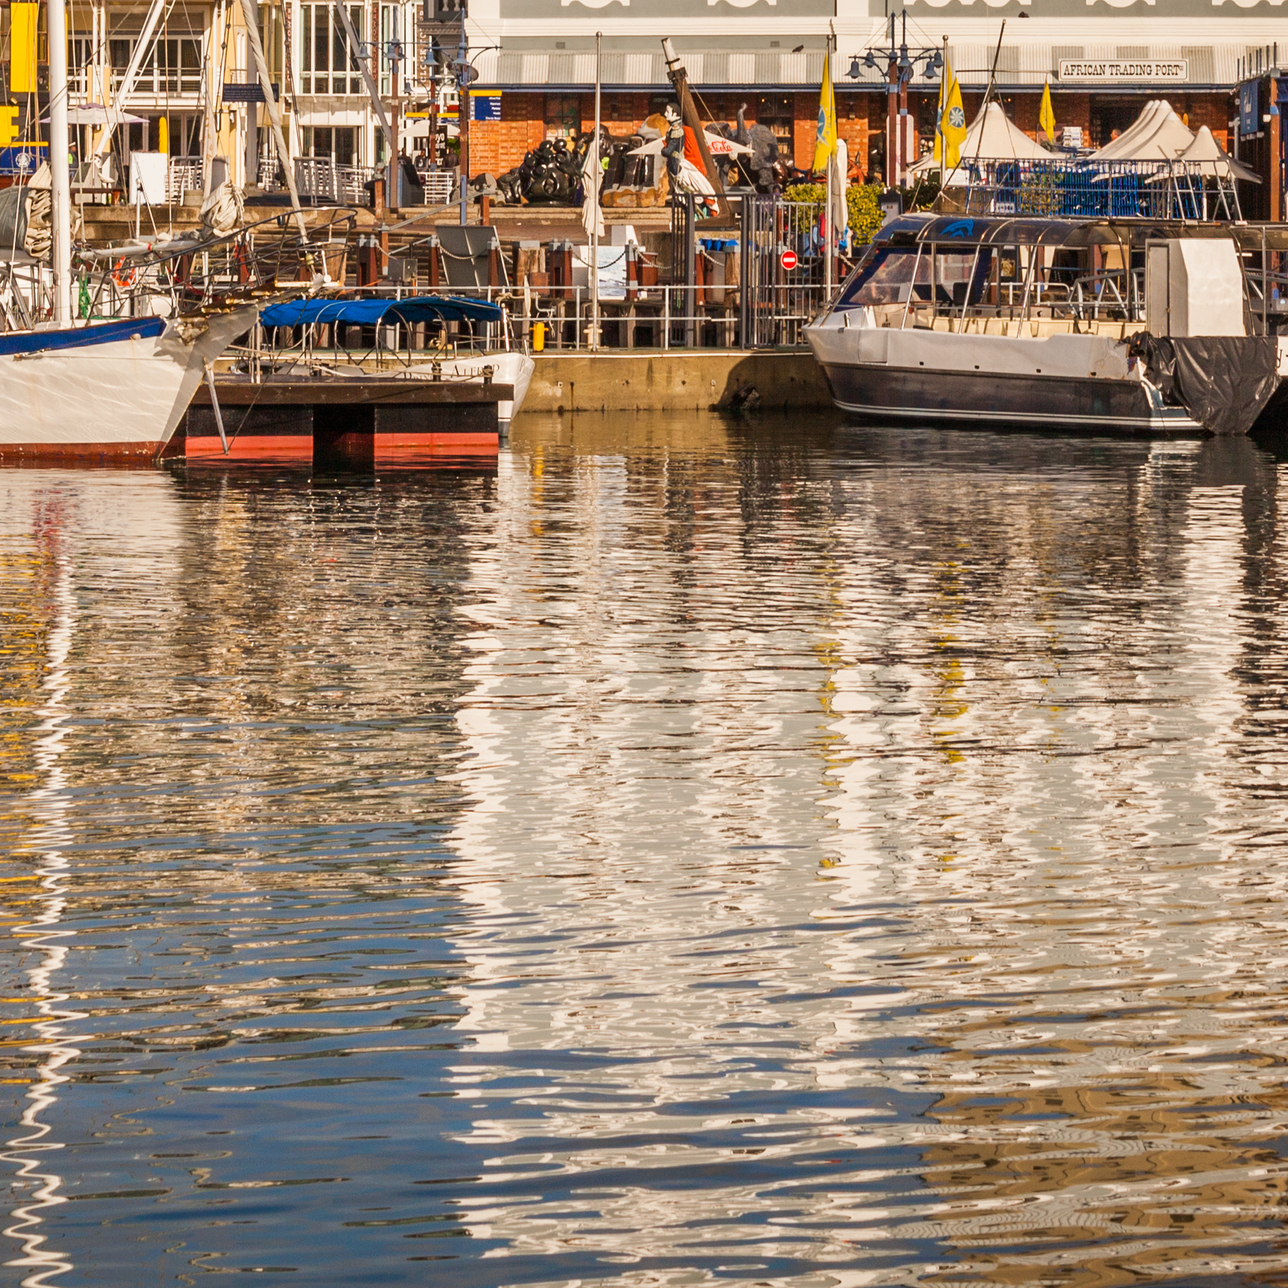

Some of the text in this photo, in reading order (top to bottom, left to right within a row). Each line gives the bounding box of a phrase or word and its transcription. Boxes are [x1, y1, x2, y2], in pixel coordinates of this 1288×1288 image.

[1064, 65, 1106, 76] AFRICAN
[1109, 65, 1152, 76] TRADING
[1155, 65, 1179, 76] PORT
